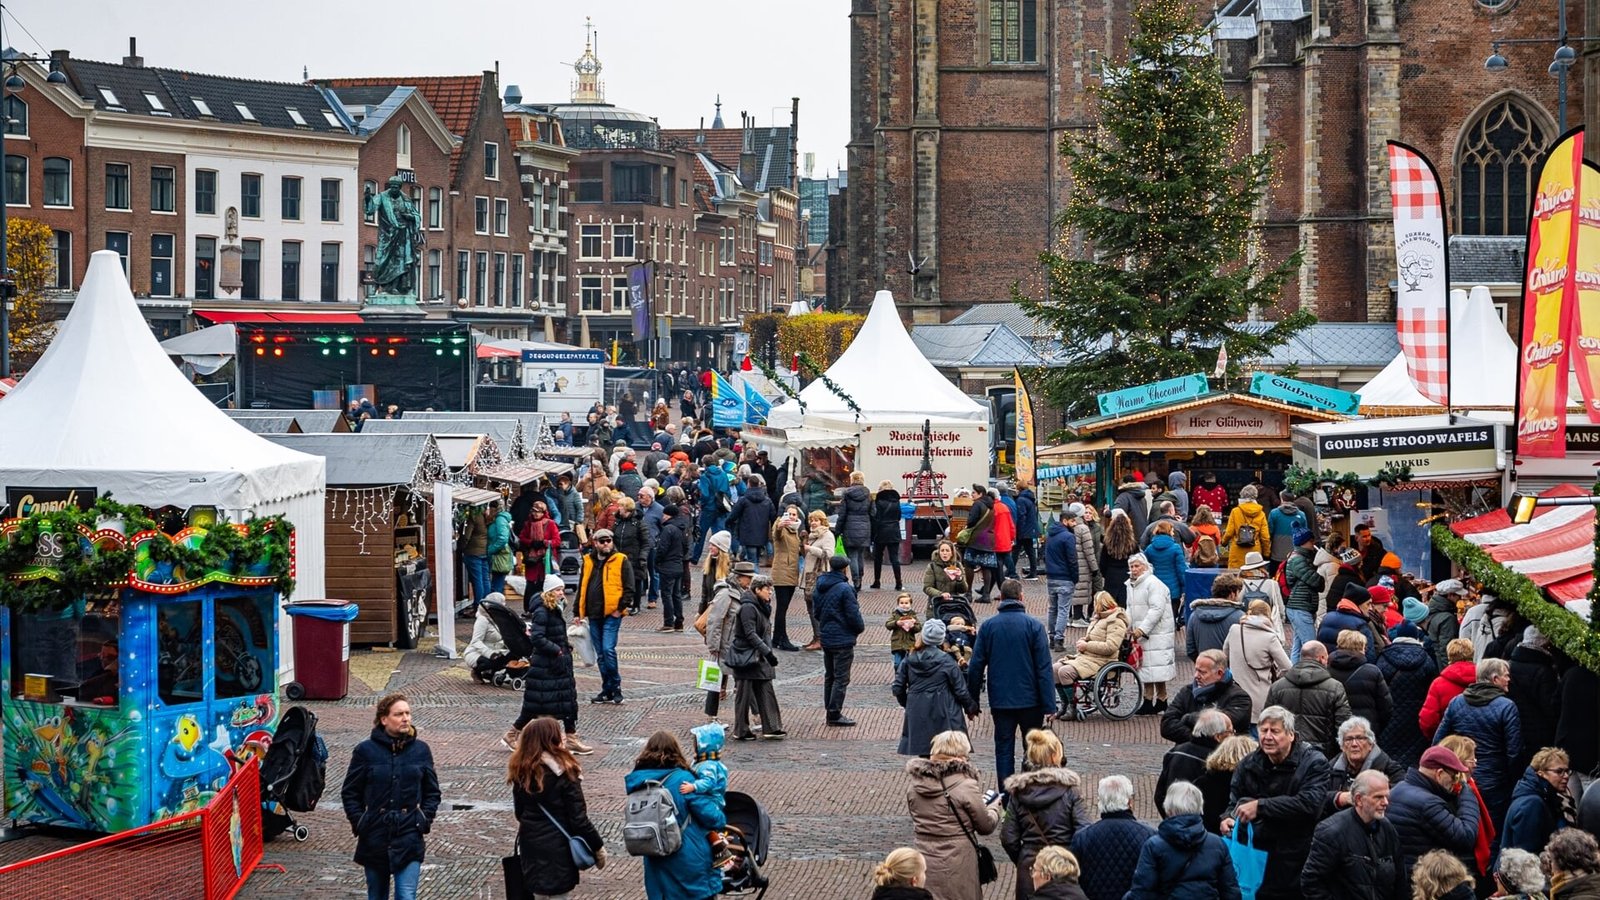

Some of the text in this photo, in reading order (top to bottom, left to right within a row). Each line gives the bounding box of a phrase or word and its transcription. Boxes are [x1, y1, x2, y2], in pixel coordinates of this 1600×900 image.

[397, 171, 418, 183] HOTEL
[1115, 378, 1187, 410] Warme Chocomel
[1189, 416, 1263, 429] Hier Glühwein
[889, 430, 961, 444] Nostagische
[1325, 431, 1488, 450] GOUDSE STROOPWAFELS
[876, 445, 973, 457] Miniaturkermis
[1385, 458, 1430, 469] MARKUS
[17, 489, 79, 519] Cannoli
